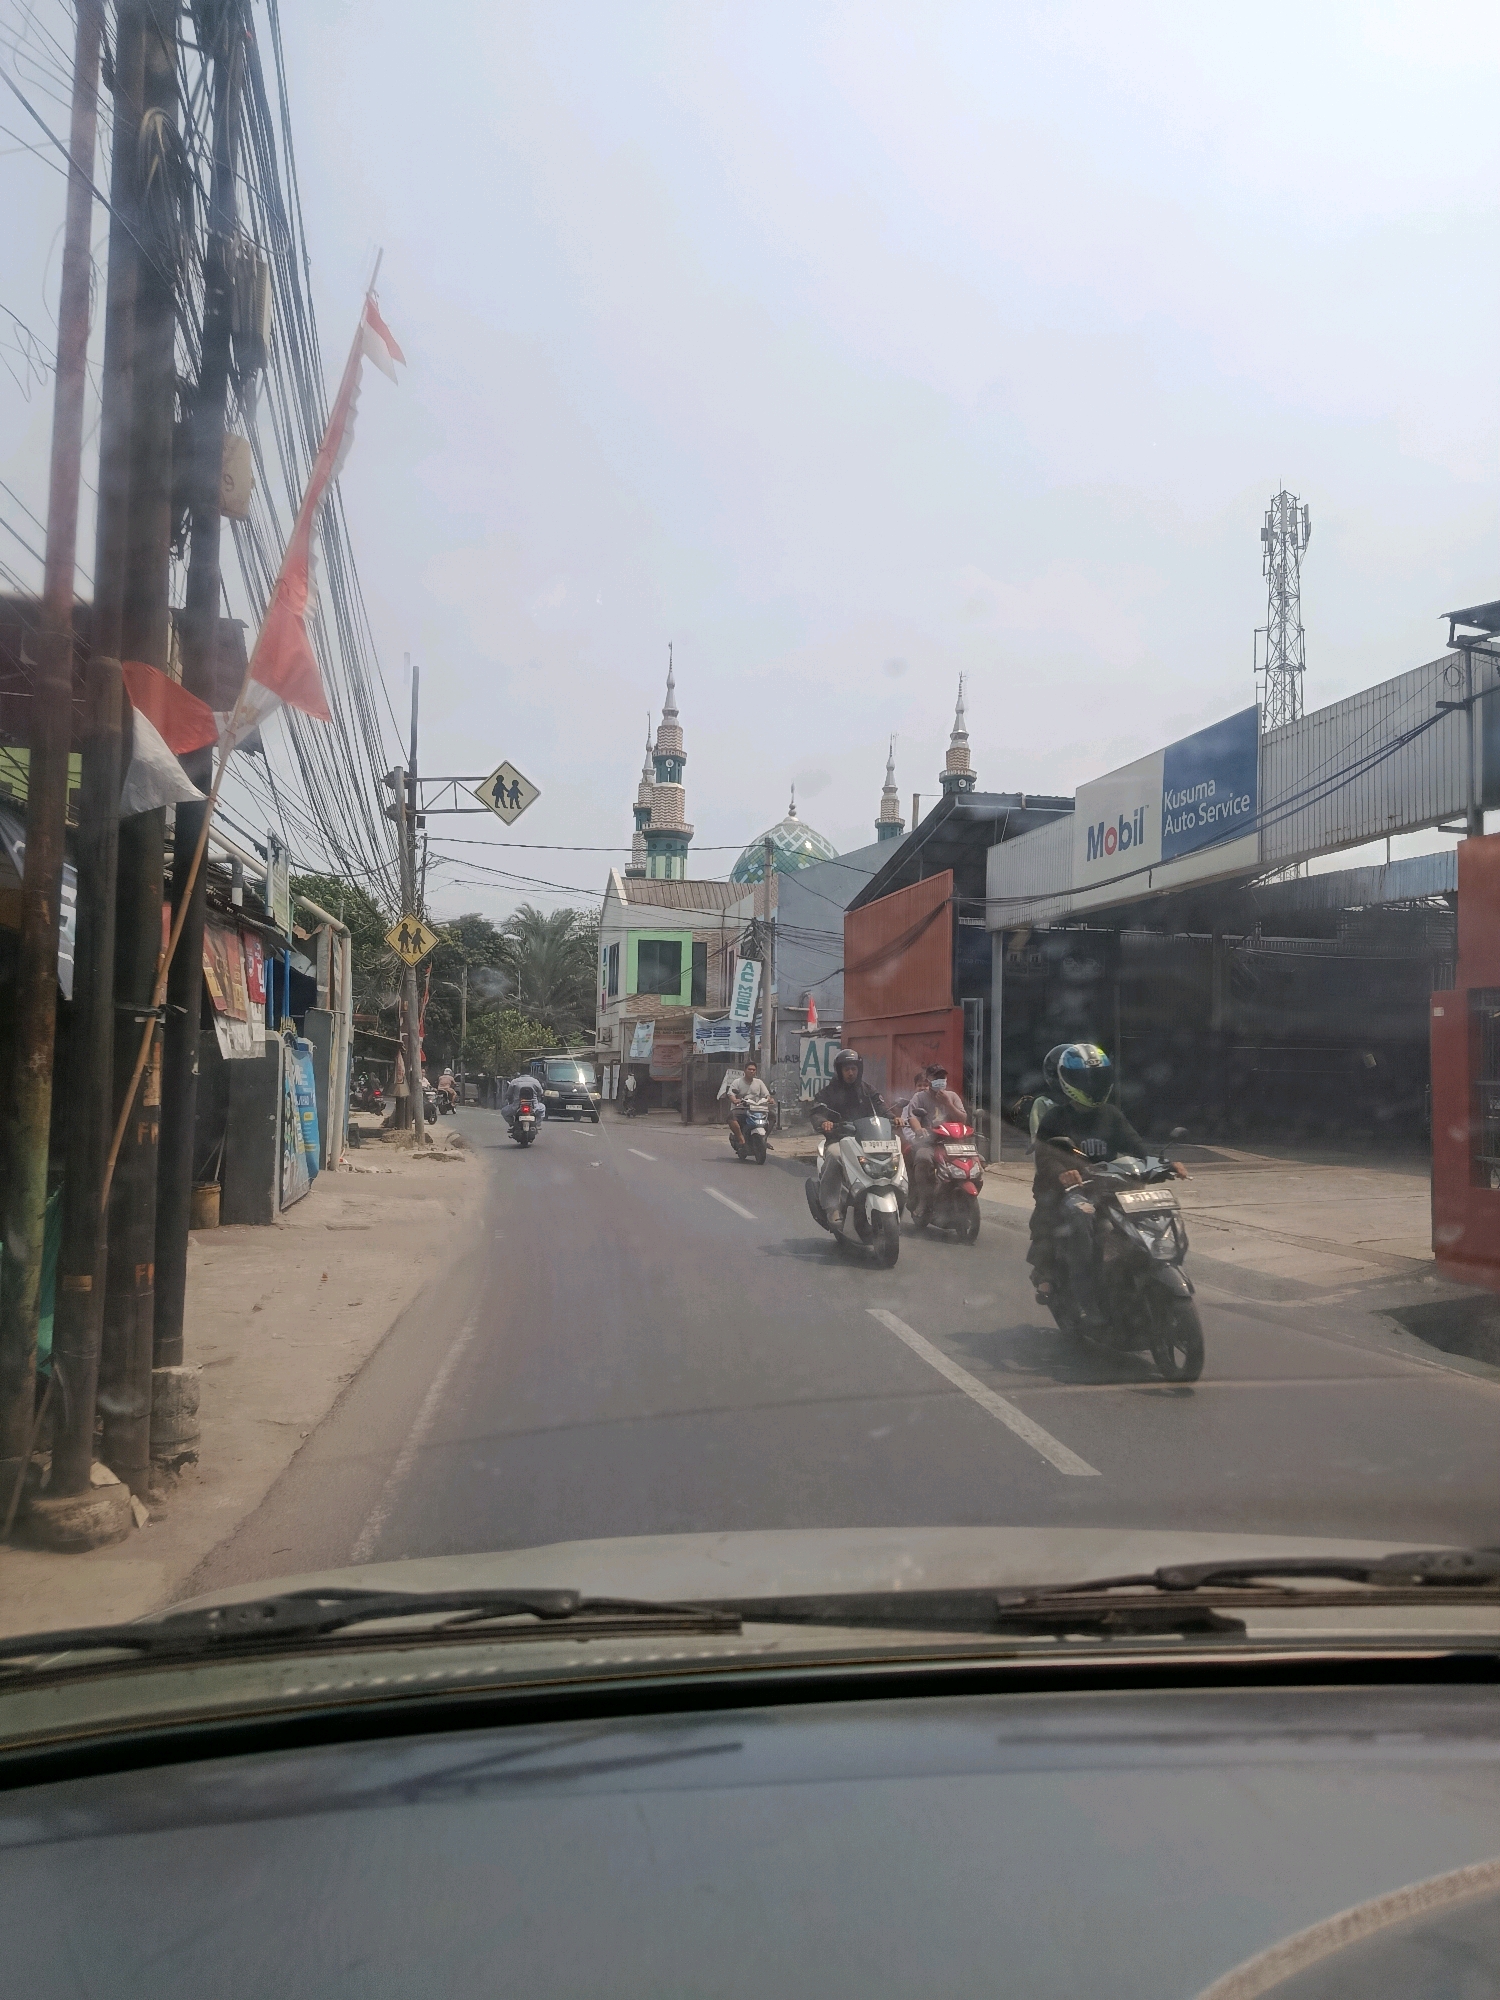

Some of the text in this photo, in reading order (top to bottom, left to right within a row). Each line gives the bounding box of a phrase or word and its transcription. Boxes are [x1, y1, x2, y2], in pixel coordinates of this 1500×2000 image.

[1164, 779, 1216, 812] Kusuma
[1163, 792, 1250, 837] Auto Service
[1086, 806, 1145, 862] Mobil
[740, 961, 754, 983] AC
[801, 1040, 842, 1077] AC
